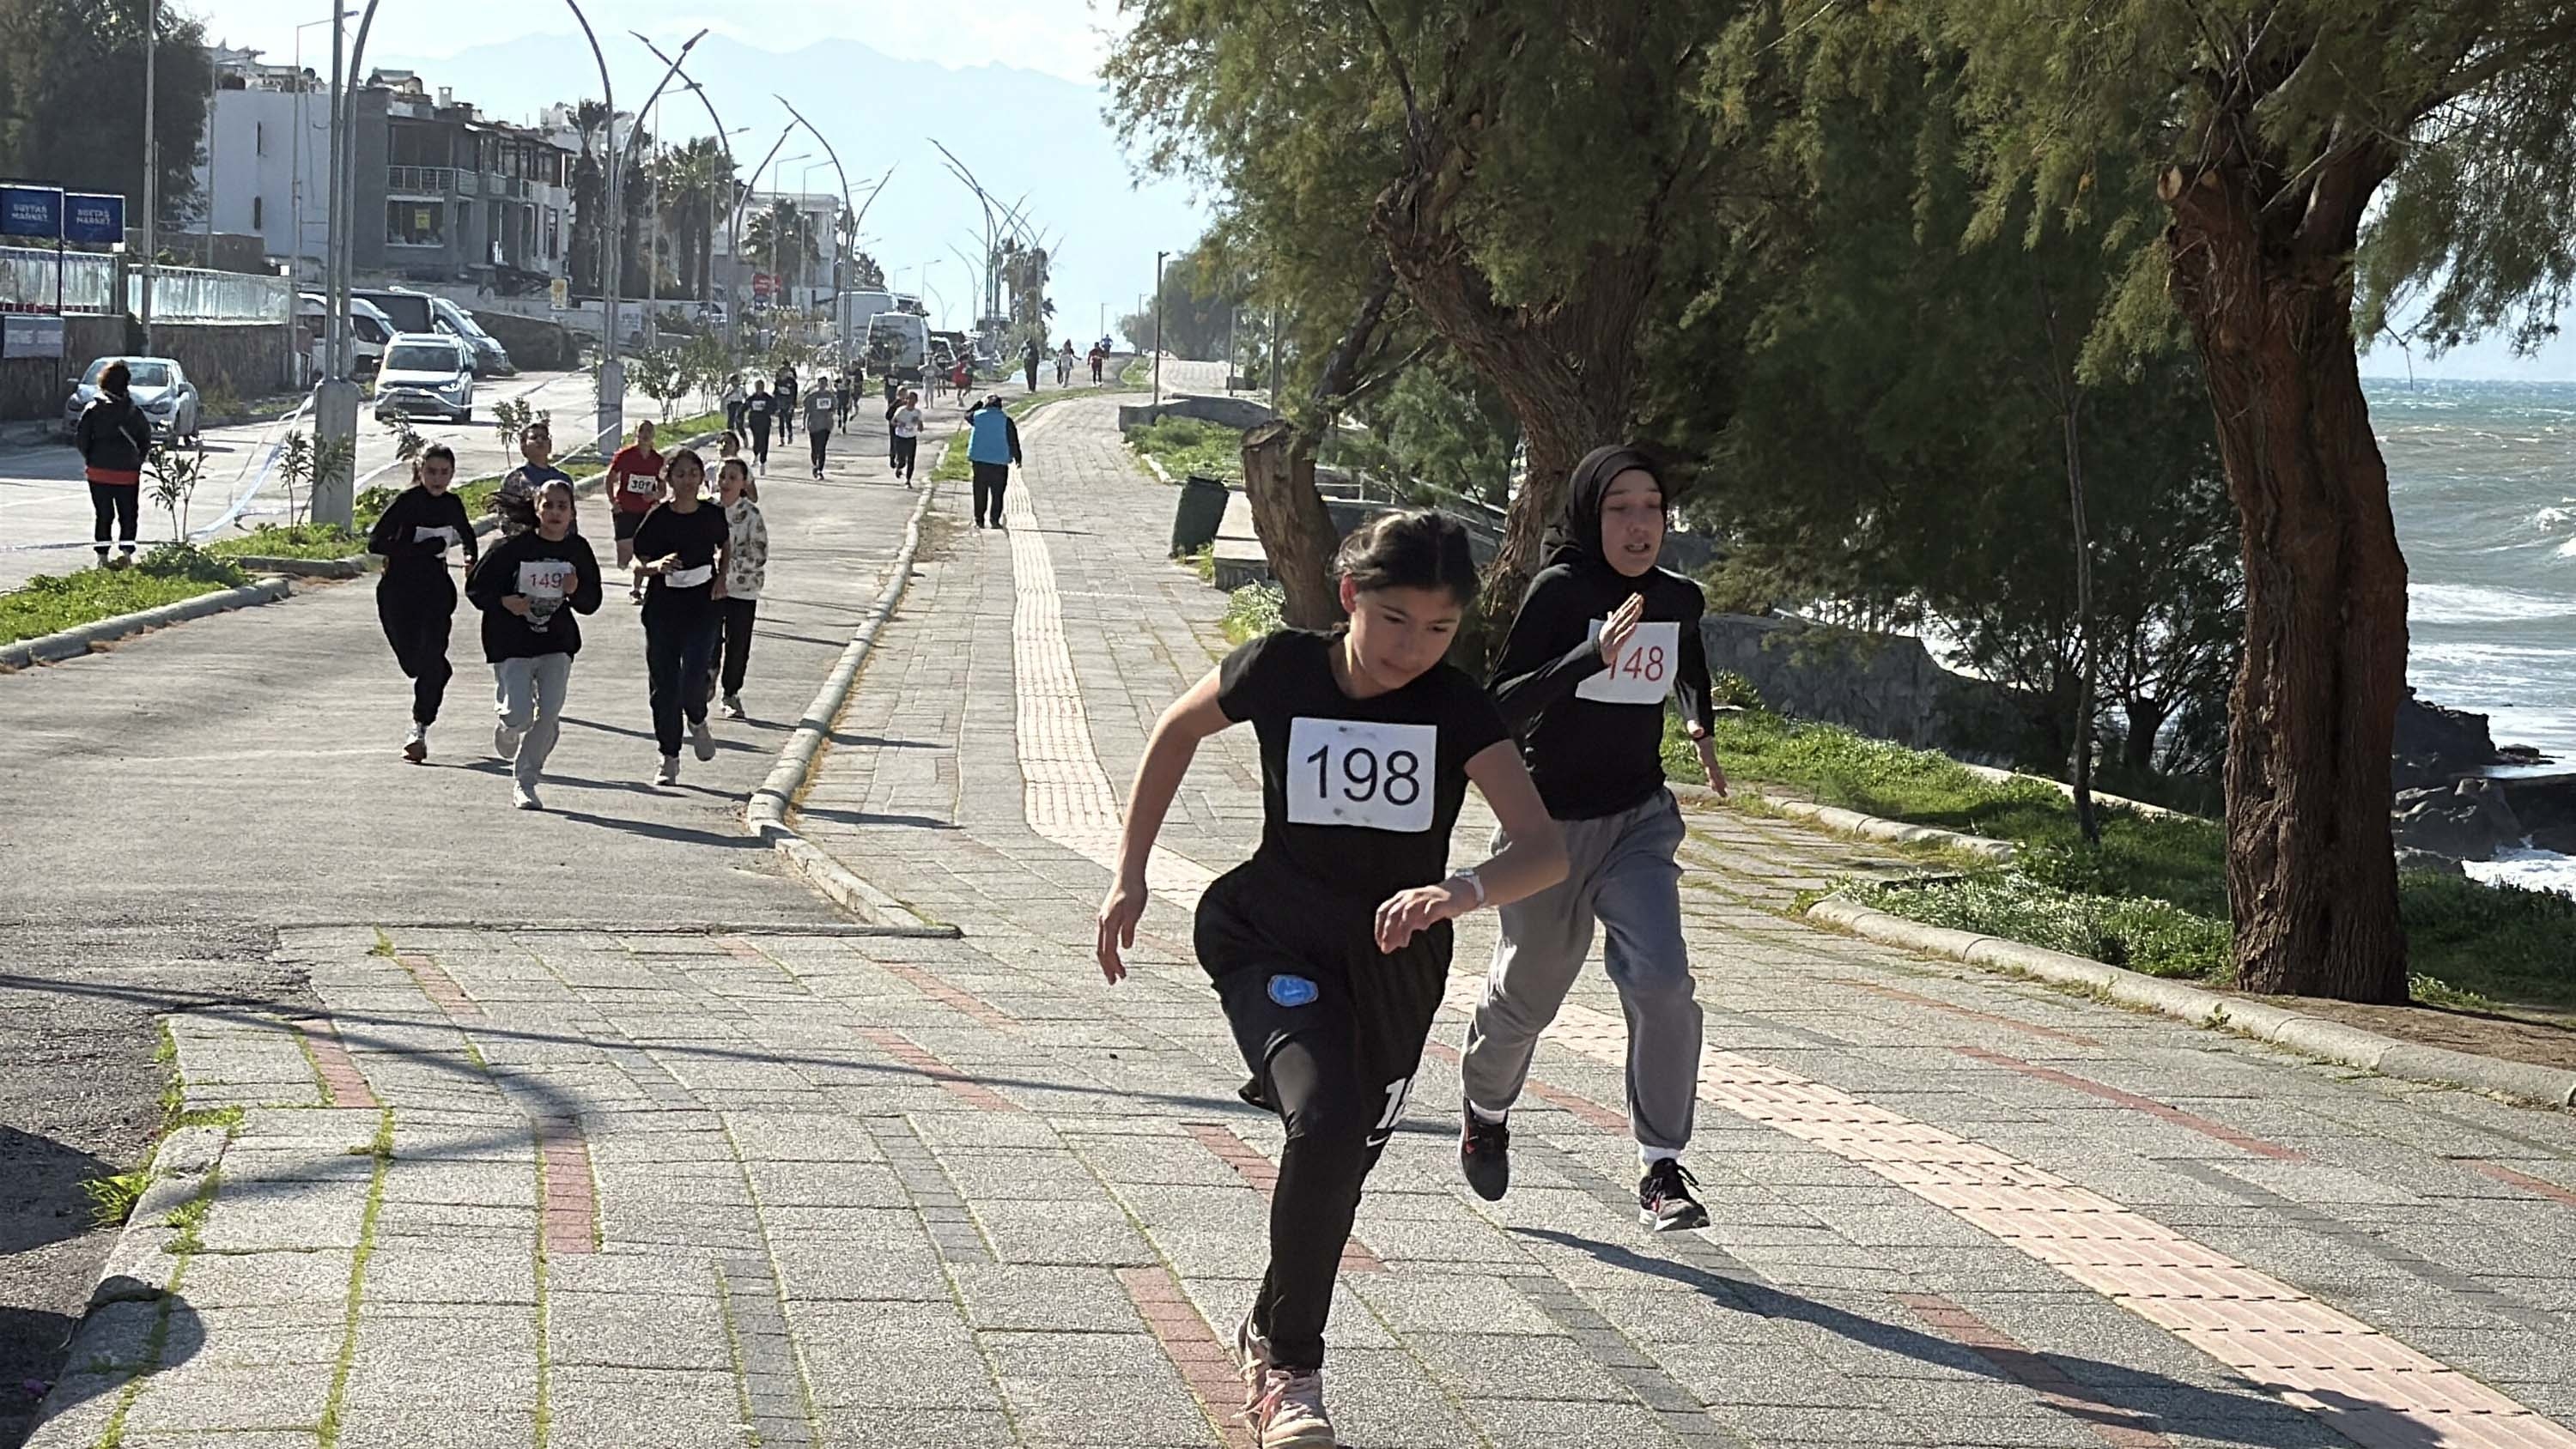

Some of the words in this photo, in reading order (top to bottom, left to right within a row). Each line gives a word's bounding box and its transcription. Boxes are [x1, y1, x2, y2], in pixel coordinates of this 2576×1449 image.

[530, 573, 562, 588] 149
[1607, 645, 1665, 682] 148
[1306, 744, 1419, 806] 198
